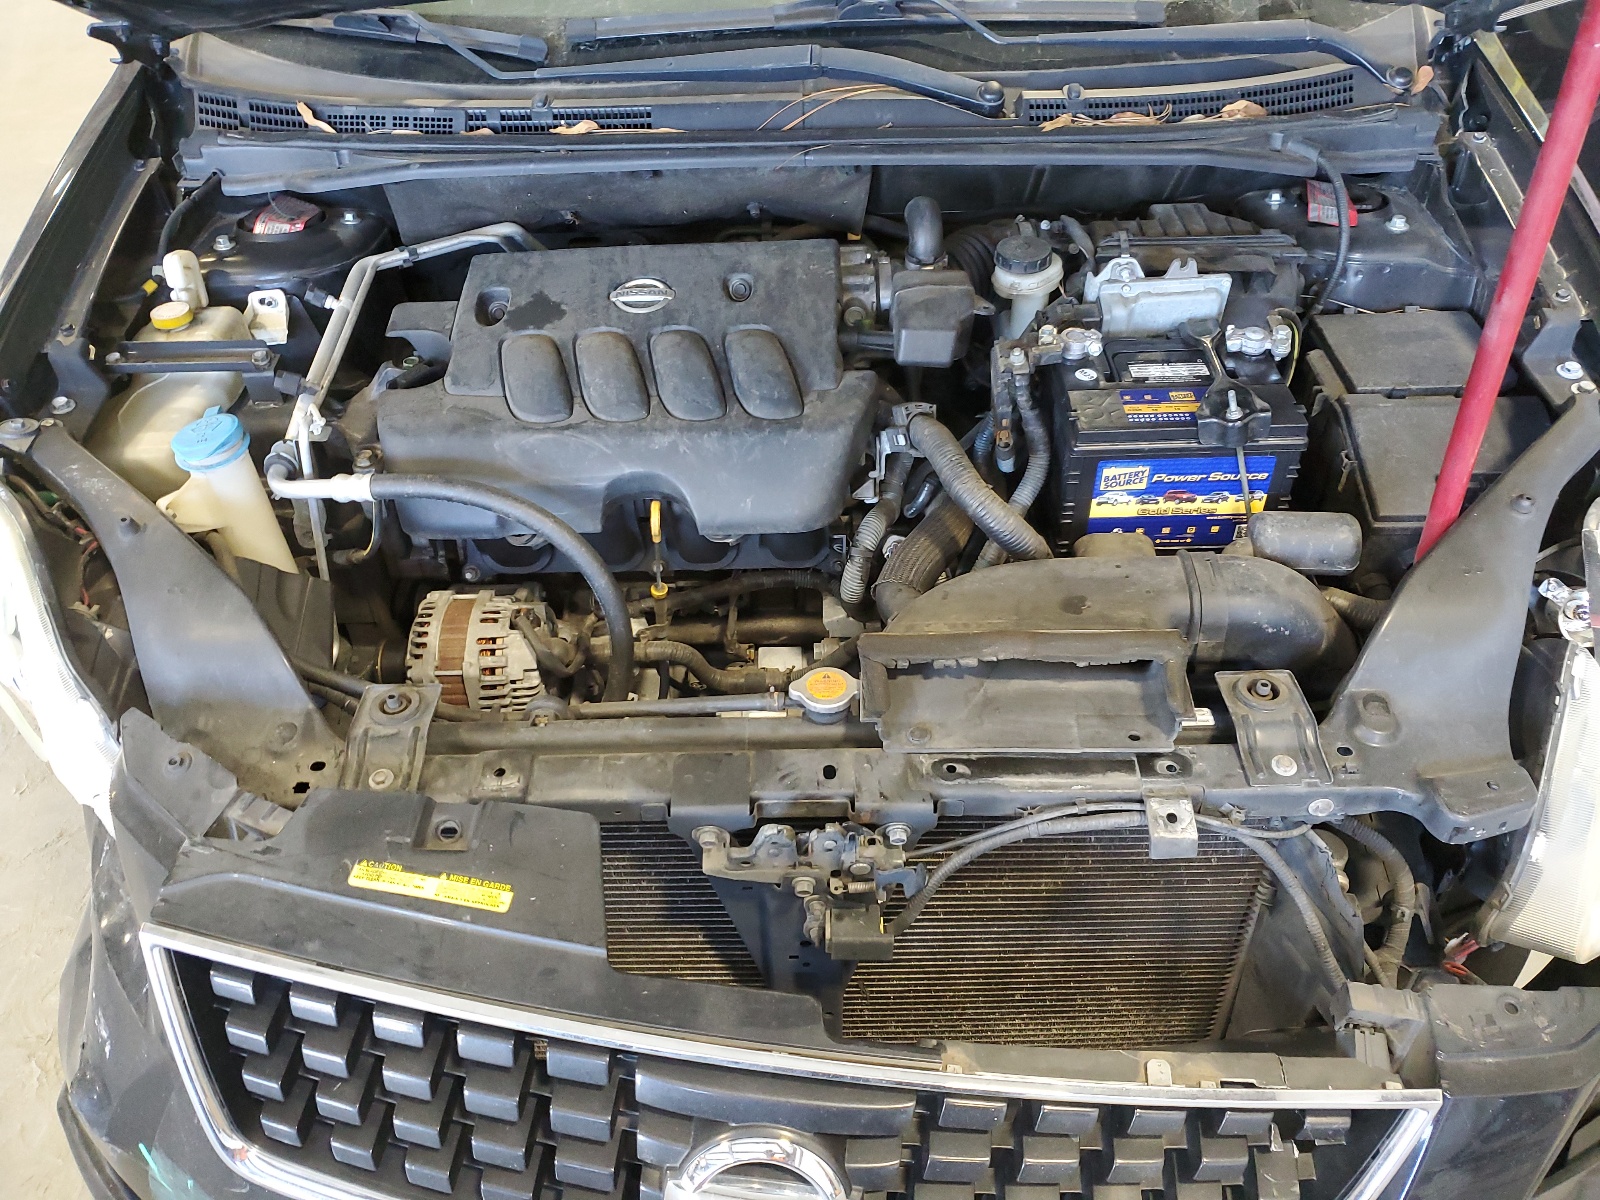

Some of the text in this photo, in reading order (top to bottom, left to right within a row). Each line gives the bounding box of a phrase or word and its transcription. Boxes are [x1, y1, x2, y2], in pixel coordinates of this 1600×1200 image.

[1103, 469, 1147, 482] BATTERY
[1151, 473, 1208, 483] Power
[1103, 477, 1144, 489] SOURCE
[1137, 507, 1217, 516] Gold Series
[368, 860, 402, 872] CAUTION
[449, 874, 470, 884] MISE
[470, 878, 483, 886] EN
[482, 880, 511, 892] GARDE
